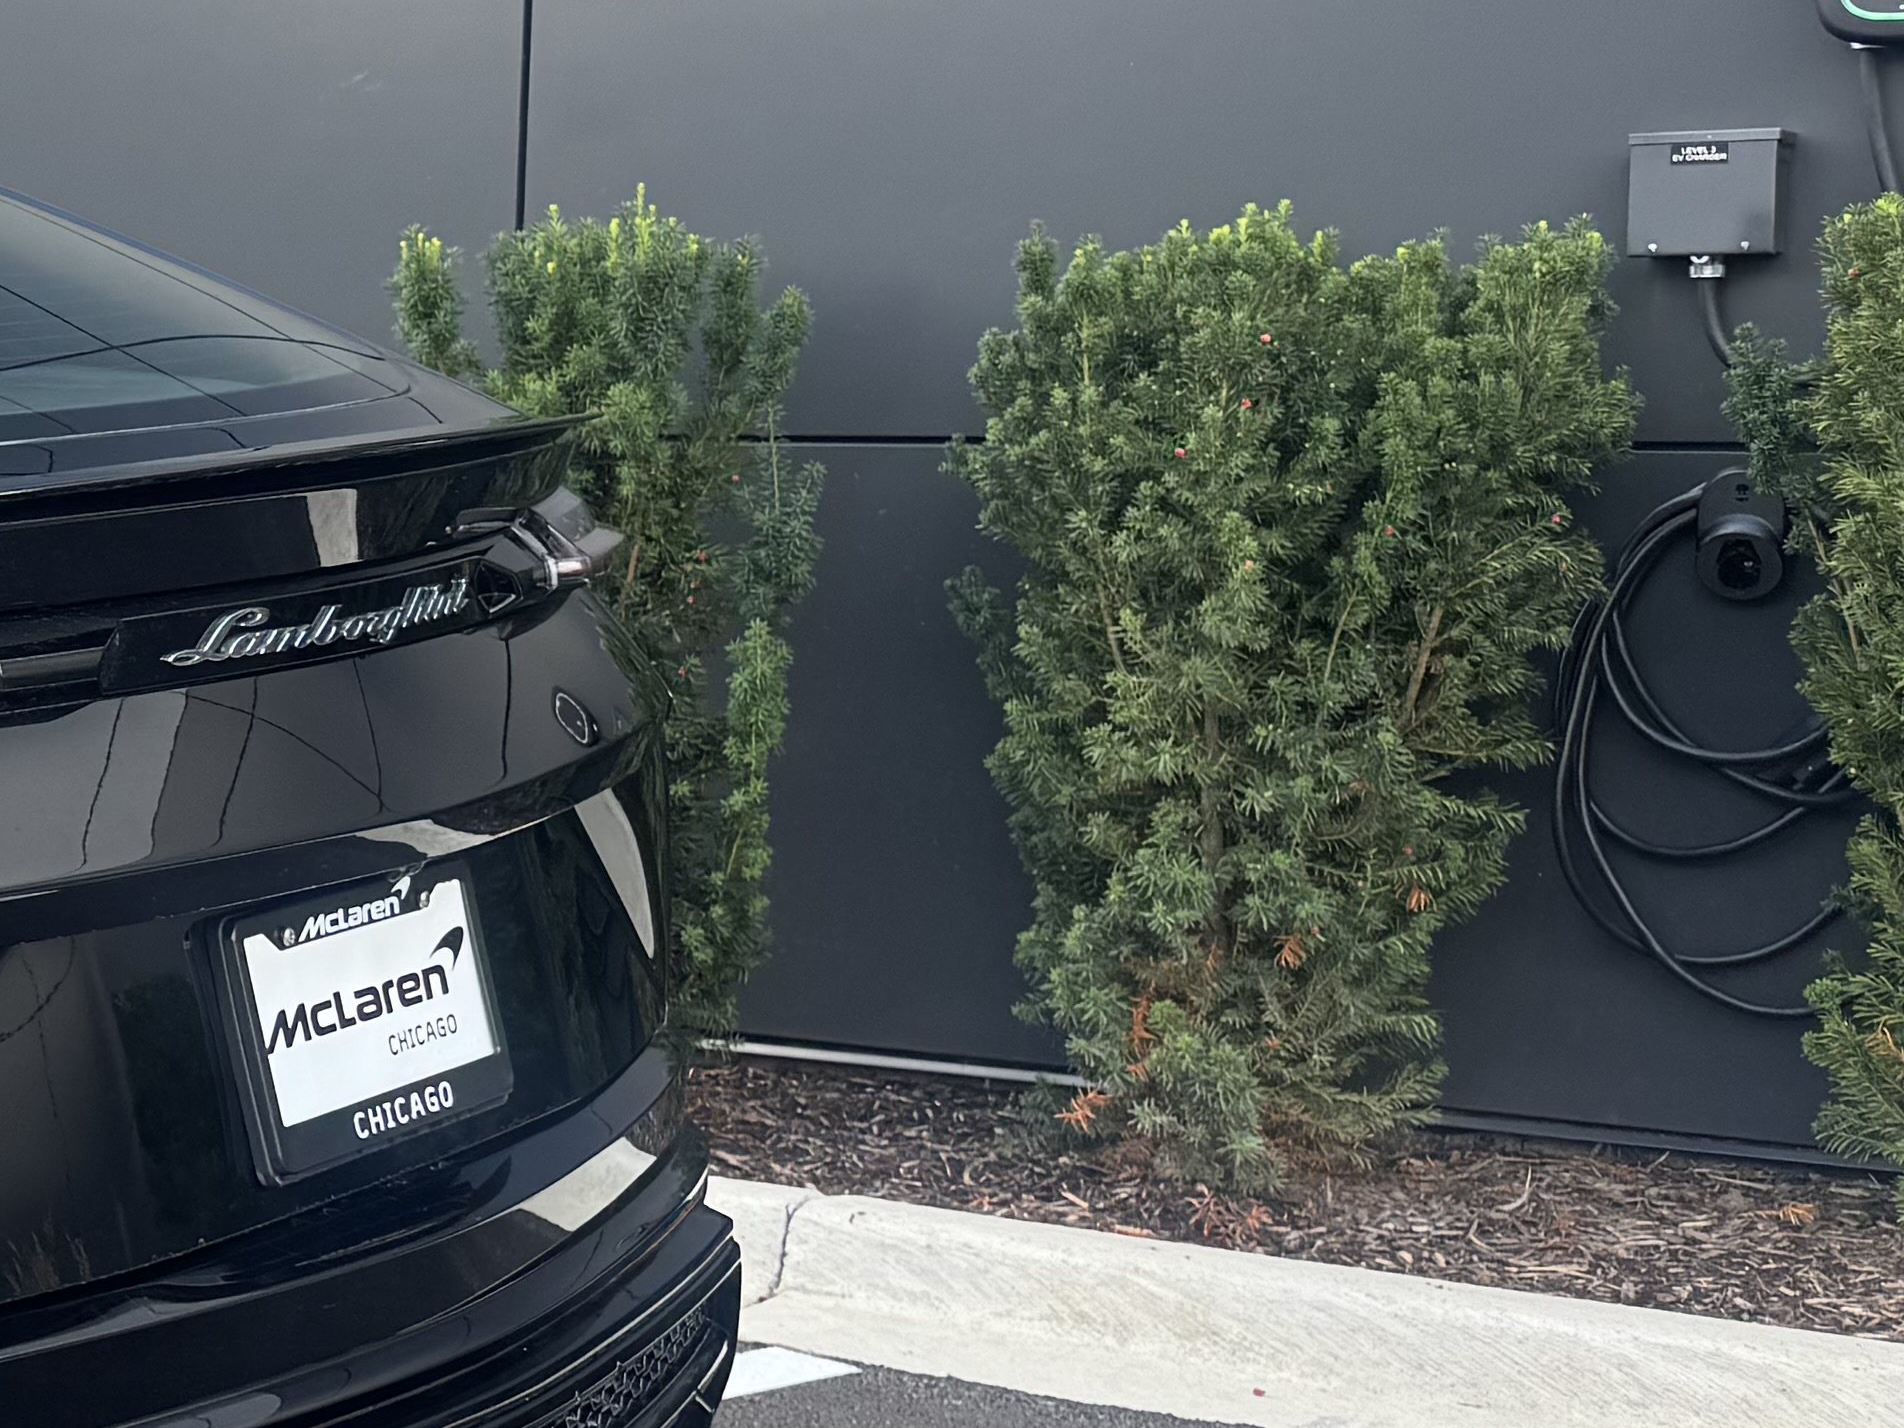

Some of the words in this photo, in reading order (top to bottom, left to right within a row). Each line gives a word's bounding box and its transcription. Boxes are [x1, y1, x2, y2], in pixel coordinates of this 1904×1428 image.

[160, 574, 469, 666] Lamborghini
[297, 895, 400, 943] McLaren
[266, 964, 450, 1054] McLaren
[388, 1013, 458, 1056] CHICAGO
[353, 1080, 454, 1139] CHICAGO
